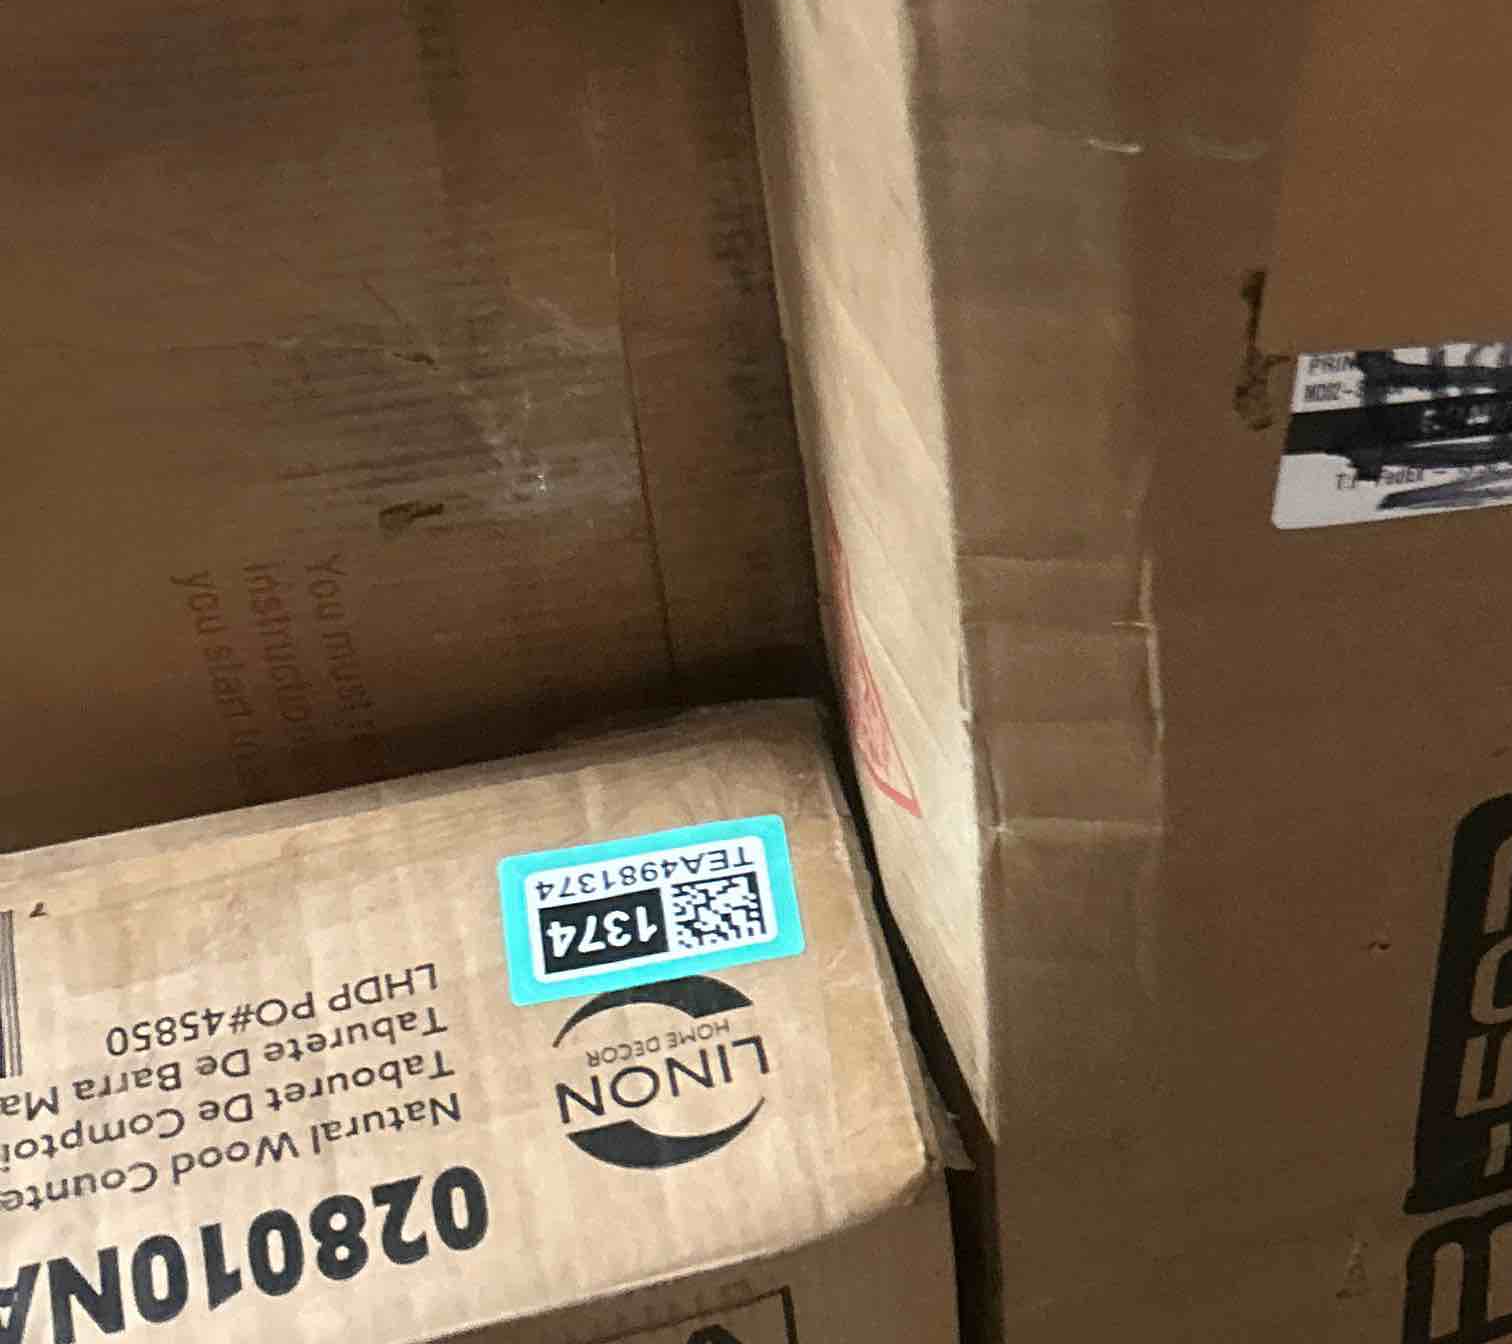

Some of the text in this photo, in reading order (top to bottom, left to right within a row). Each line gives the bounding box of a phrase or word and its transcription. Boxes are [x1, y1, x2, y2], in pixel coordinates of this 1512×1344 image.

[303, 554, 349, 621] You
[535, 846, 756, 902] TEA4981374
[546, 906, 659, 958] 1374
[106, 962, 438, 1057] LHDP PO#45850
[586, 1018, 731, 1068] HOME DECOR
[0, 1006, 449, 1122] Taburete De Barra Ma
[555, 1035, 770, 1124] LINON
[0, 1050, 457, 1172] Tabouret De Comptoi
[0, 1092, 462, 1213] Natural Wood Counte
